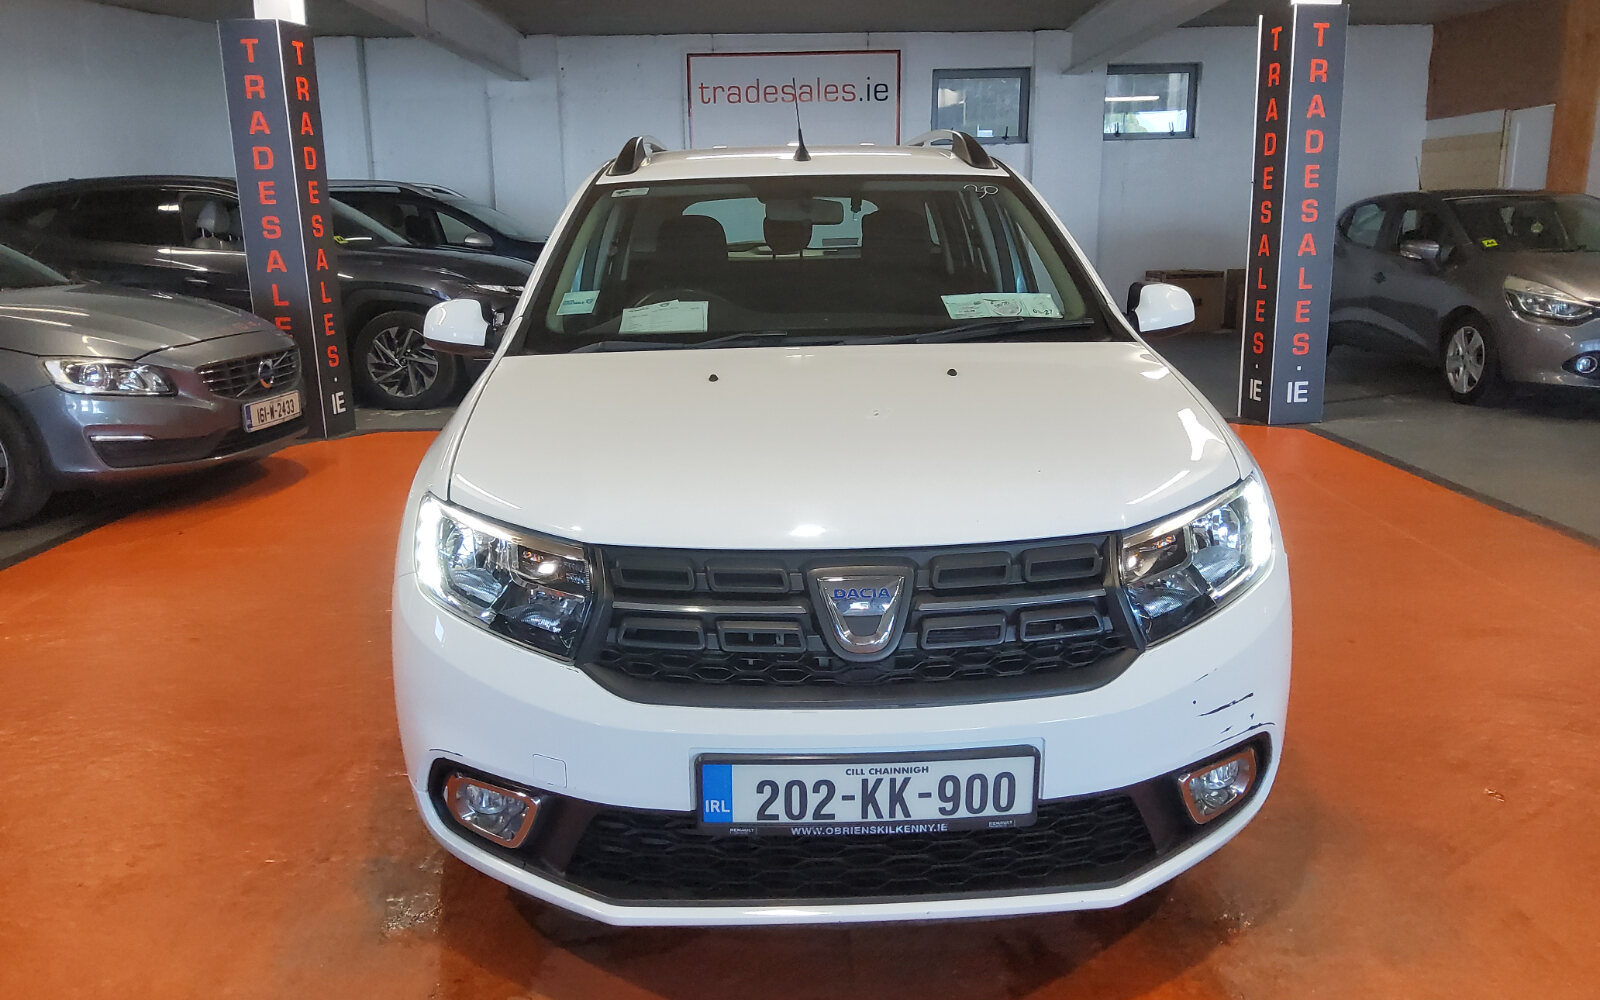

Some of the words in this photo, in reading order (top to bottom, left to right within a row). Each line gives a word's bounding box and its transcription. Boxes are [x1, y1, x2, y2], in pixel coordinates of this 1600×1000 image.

[698, 77, 889, 105] tradesales.ie
[257, 399, 295, 424] 161-W-2433
[833, 587, 891, 599] DACIA
[845, 768, 866, 777] CILL
[868, 765, 929, 776] CHAINNIGH
[756, 771, 1017, 822] 202-KK-900
[705, 799, 731, 813] IRL
[790, 822, 949, 837] WWW.OBRIENSKILKENNY.IE
